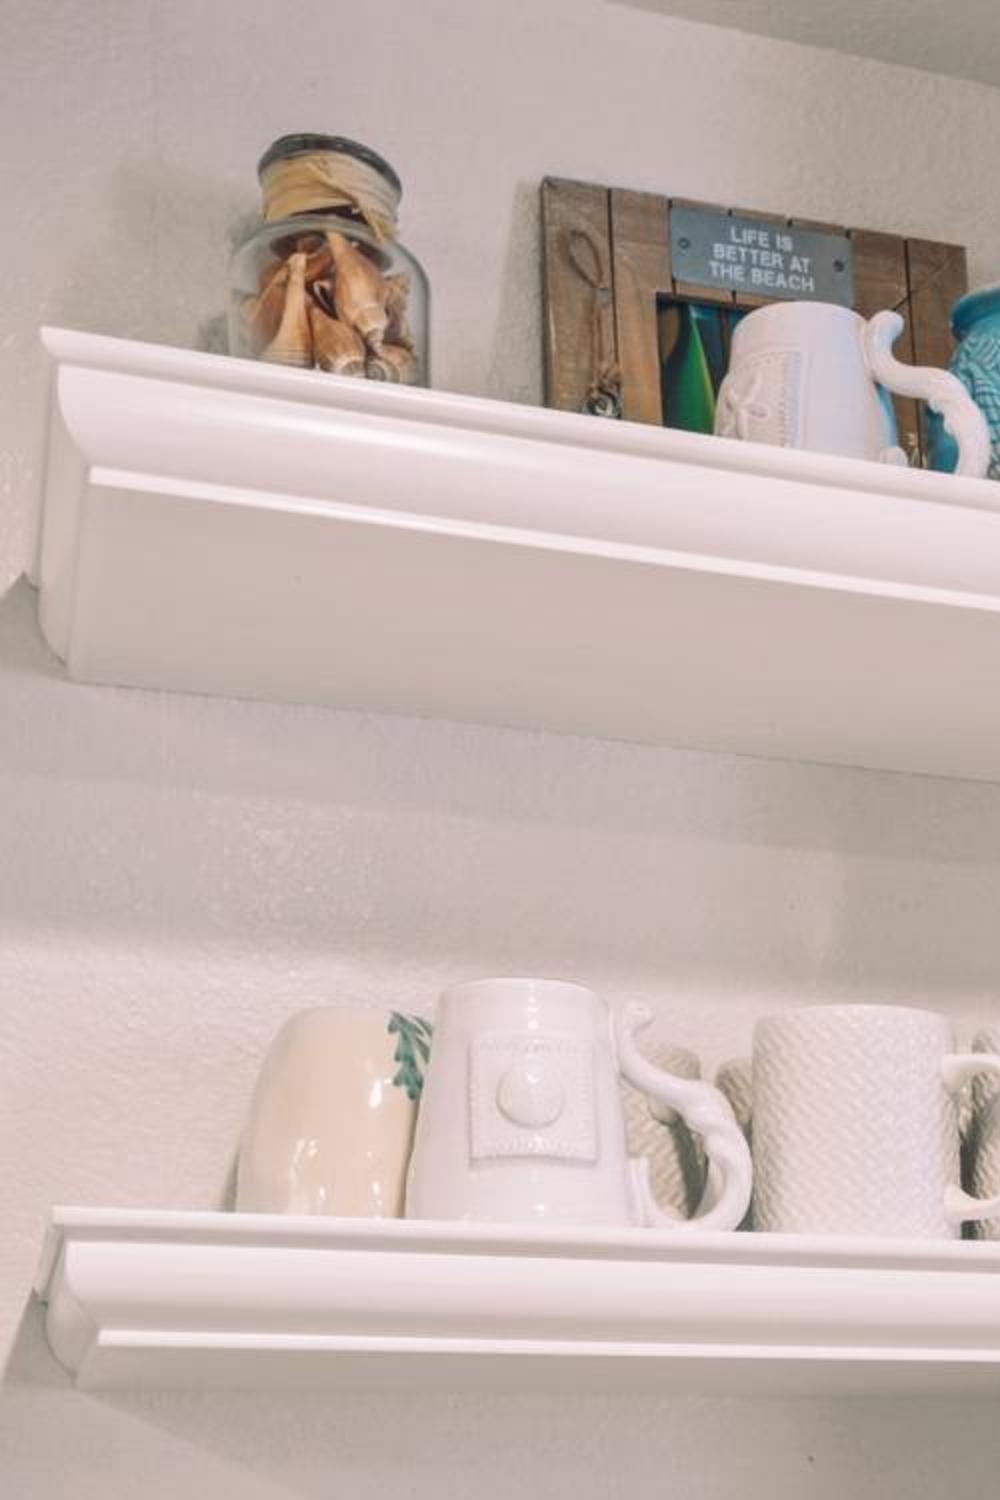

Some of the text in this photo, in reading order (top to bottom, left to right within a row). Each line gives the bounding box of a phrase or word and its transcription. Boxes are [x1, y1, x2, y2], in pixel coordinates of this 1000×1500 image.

[730, 226, 793, 252] LIFE IS
[713, 243, 811, 273] BETTER AT
[709, 260, 815, 293] THE BEACH
